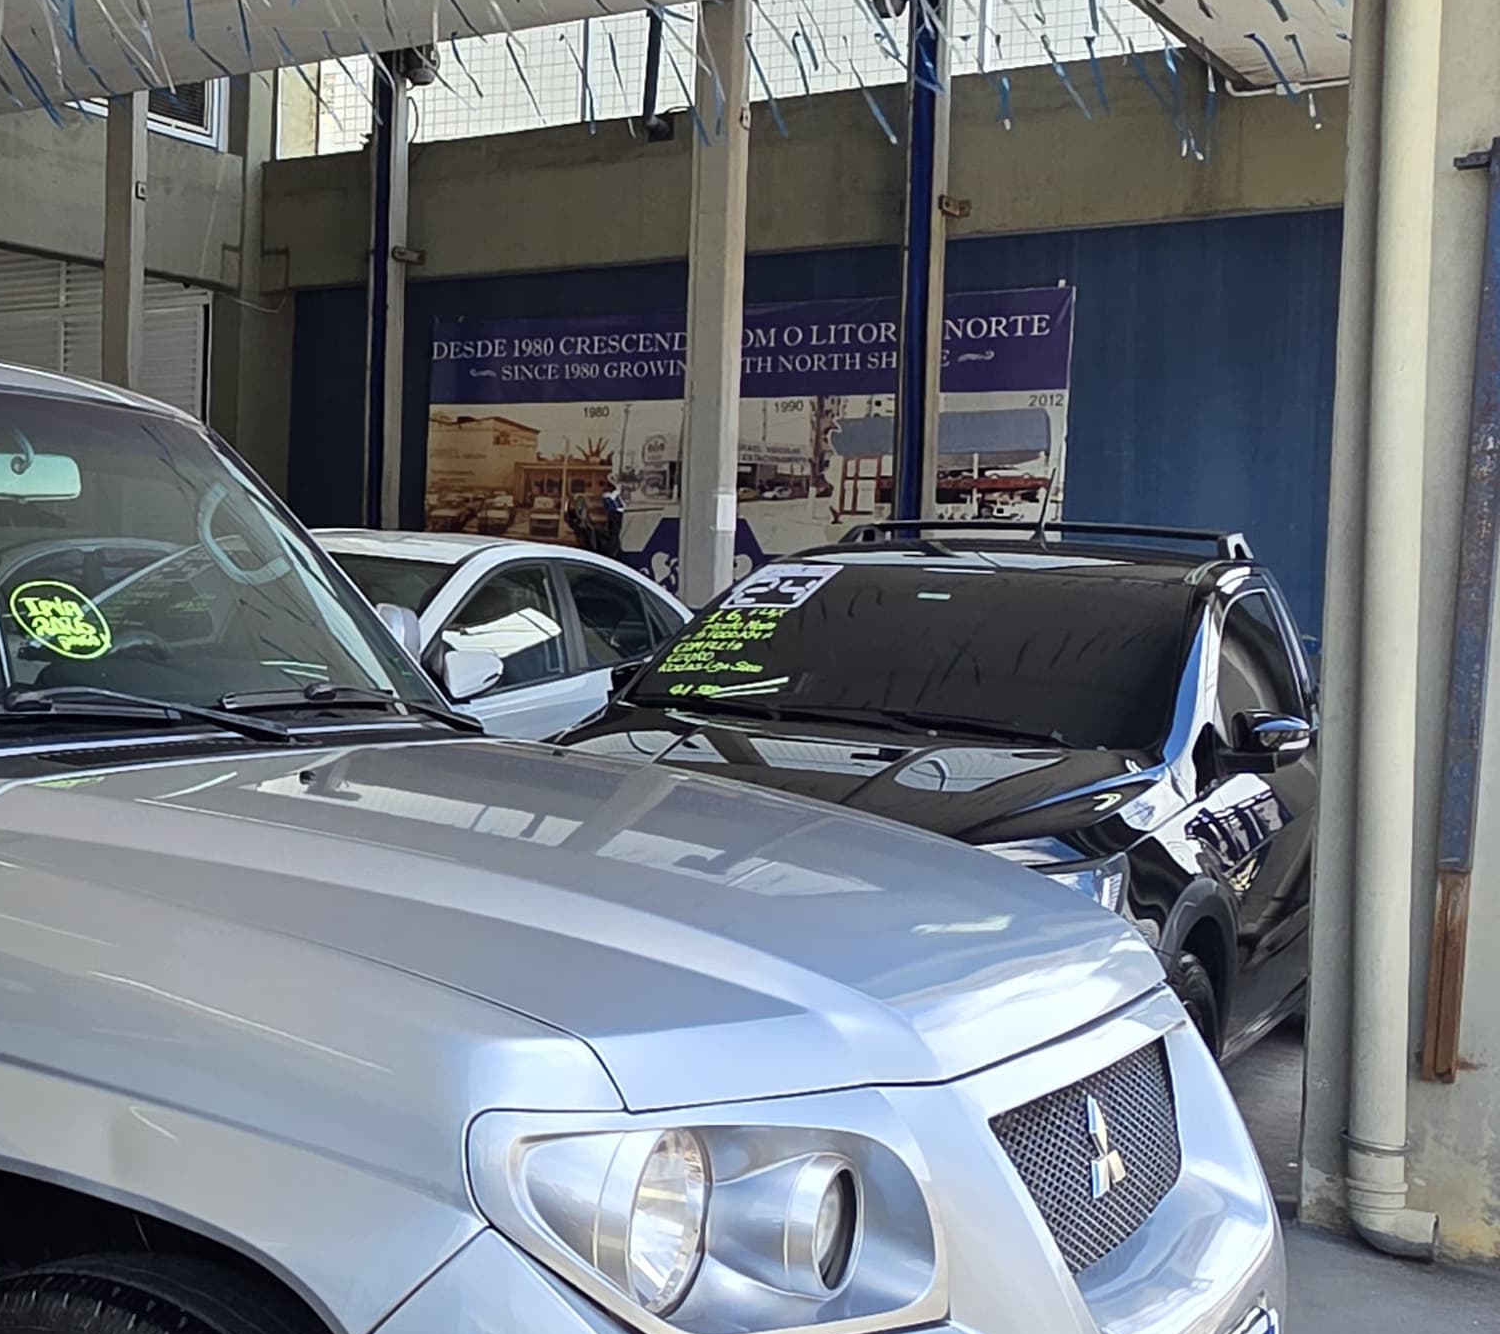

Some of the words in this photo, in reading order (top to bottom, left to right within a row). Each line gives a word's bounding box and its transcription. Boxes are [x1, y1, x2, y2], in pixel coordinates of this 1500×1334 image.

[431, 338, 508, 361] DESDE
[513, 336, 554, 357] 1980
[559, 331, 688, 357] CRESCEND
[740, 328, 776, 348] OM
[783, 326, 804, 346] O
[810, 322, 898, 346] LITOR
[944, 314, 1051, 341] NORTE
[501, 363, 560, 381] SINCE
[564, 362, 600, 380] 1980
[604, 359, 687, 378] GROWIN
[778, 352, 861, 372] NORTH
[774, 400, 804, 413] 1990
[1028, 394, 1065, 408] 2012
